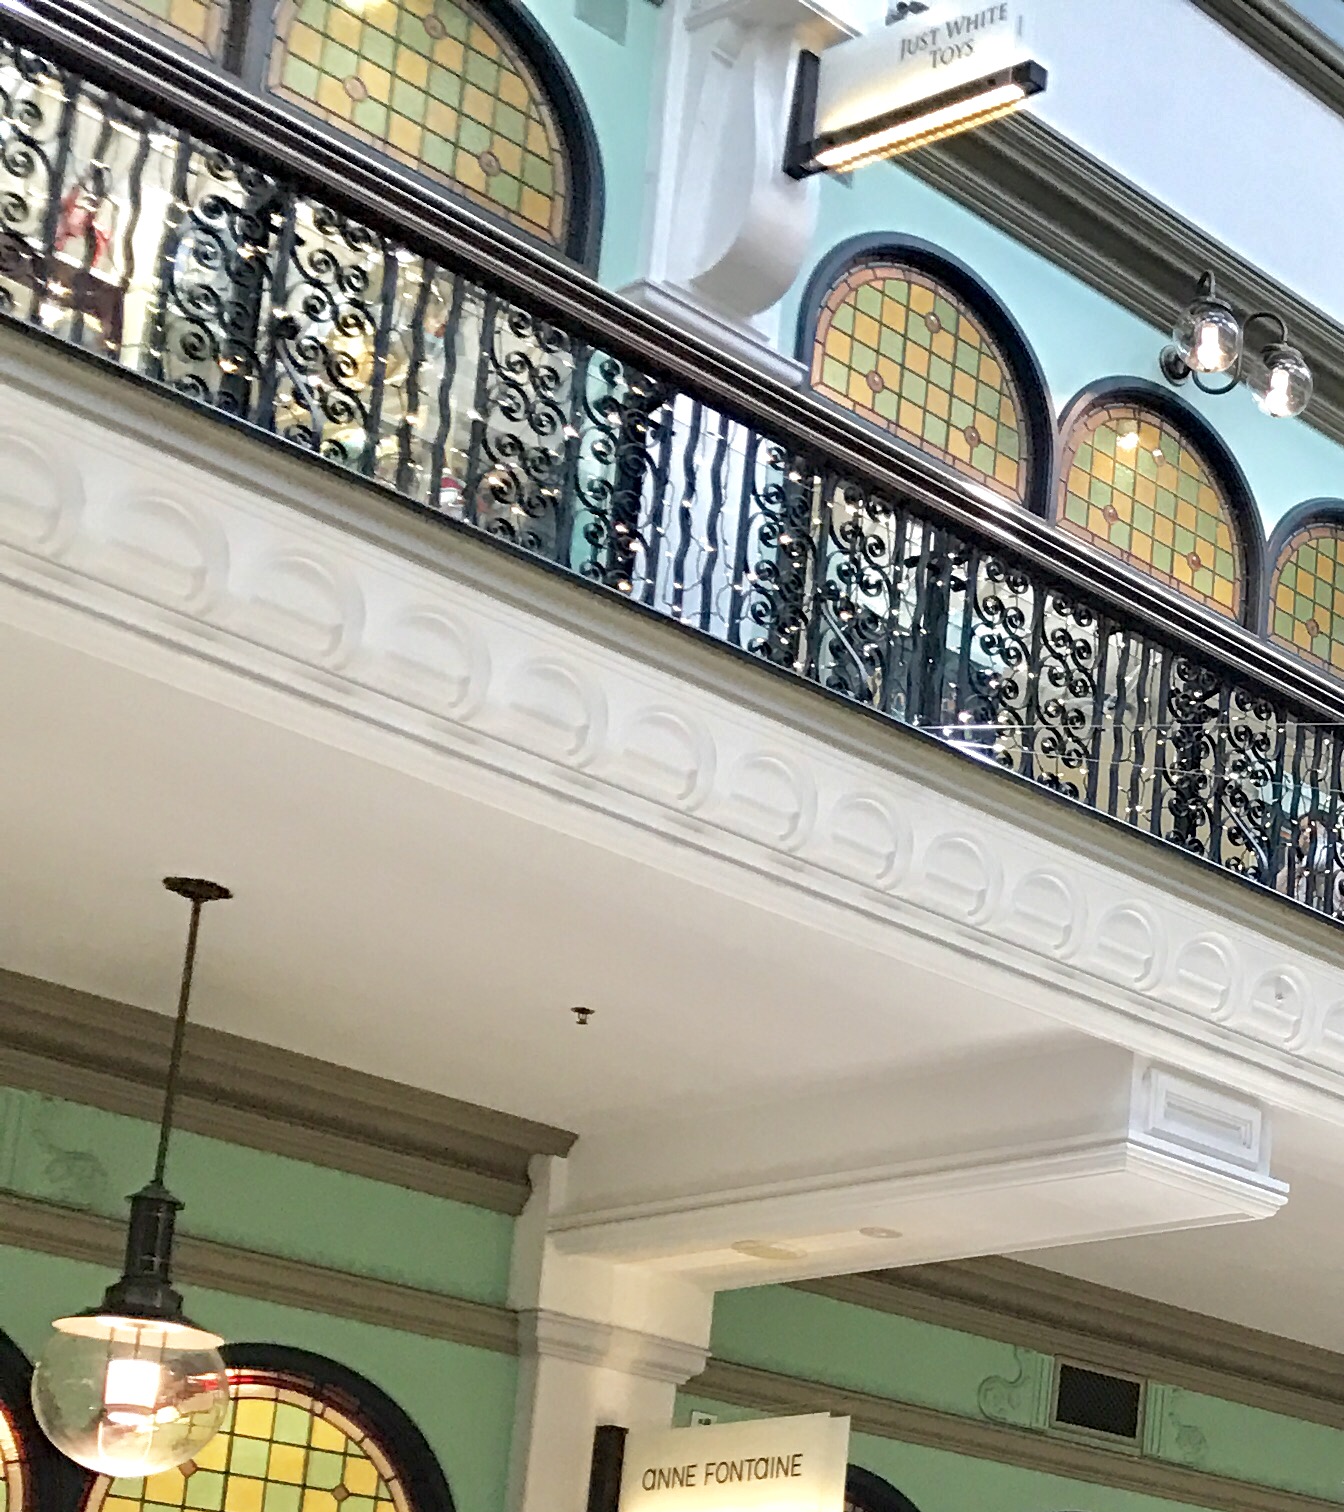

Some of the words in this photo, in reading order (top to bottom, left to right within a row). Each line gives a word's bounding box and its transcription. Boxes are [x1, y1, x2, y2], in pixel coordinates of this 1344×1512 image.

[899, 28, 939, 61] JUST
[944, 2, 1008, 39] WHITE
[928, 38, 974, 69] TOYS
